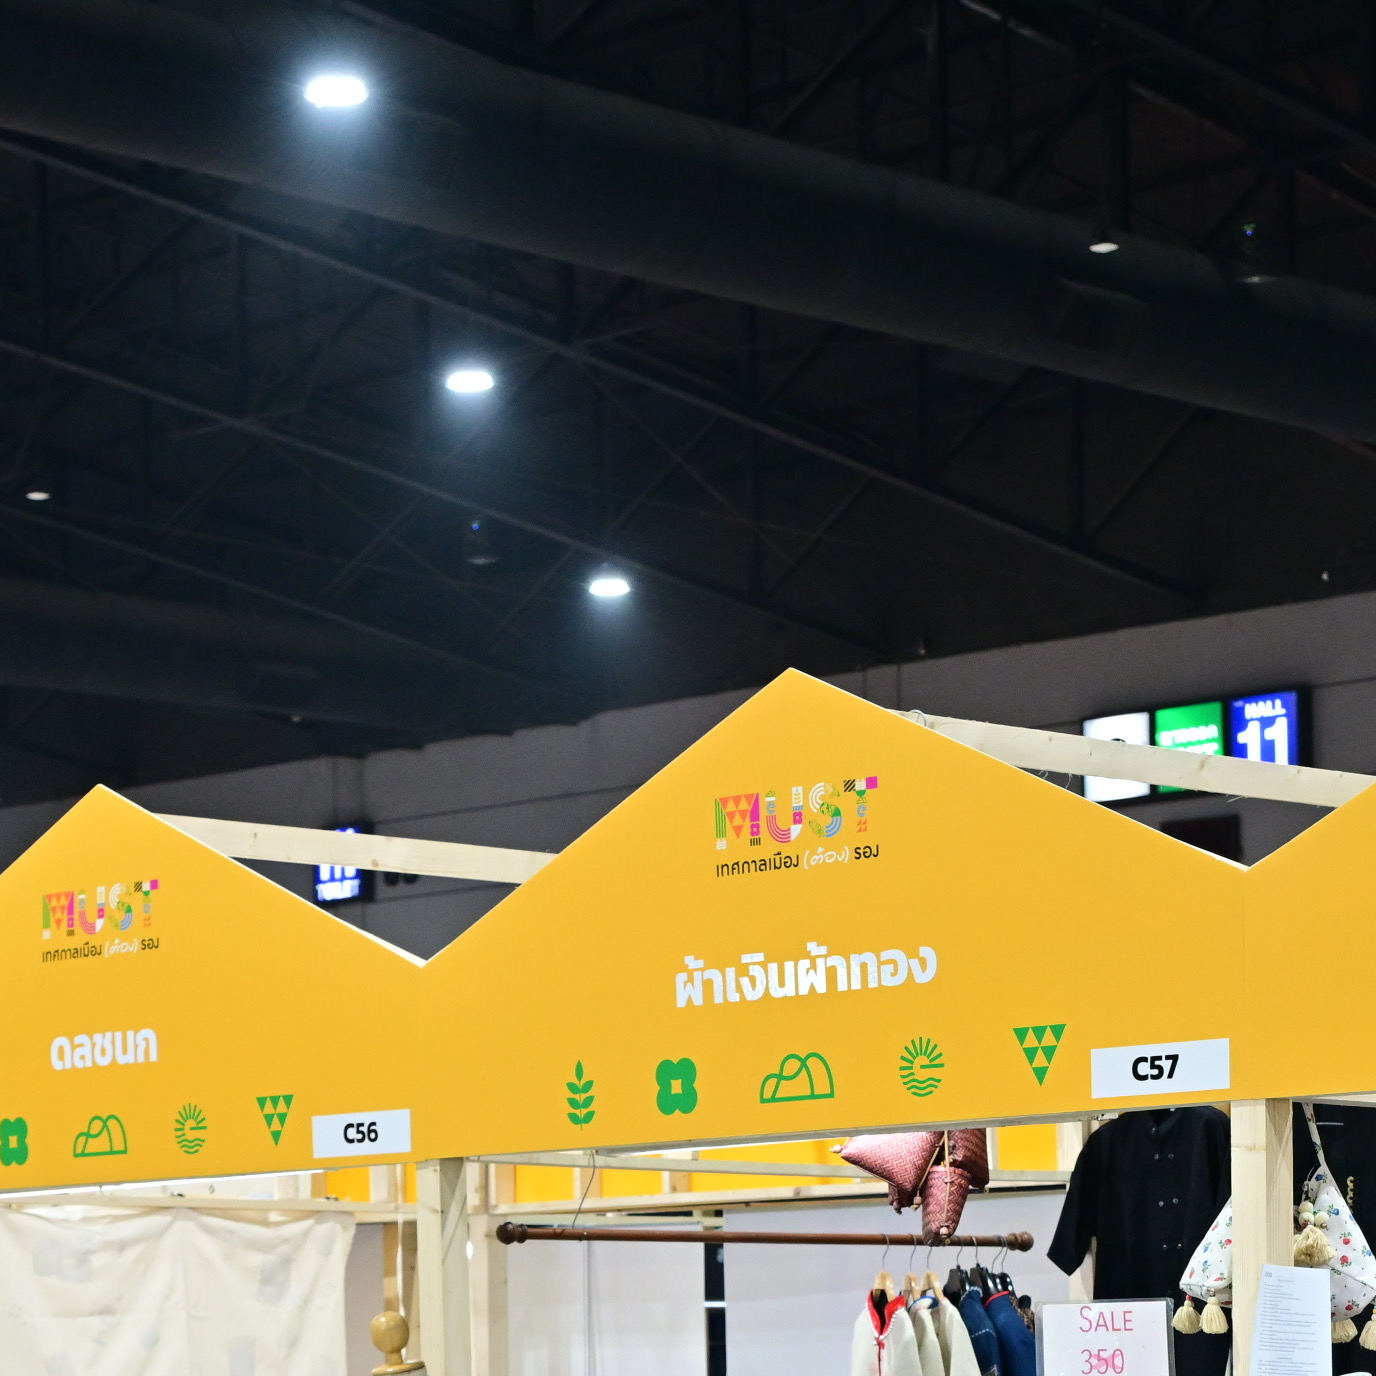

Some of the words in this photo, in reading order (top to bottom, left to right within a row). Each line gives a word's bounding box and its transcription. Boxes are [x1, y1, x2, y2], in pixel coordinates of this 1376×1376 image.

[1245, 699, 1286, 720] HALL
[1237, 716, 1288, 766] 11
[714, 775, 878, 850] MUST
[715, 850, 800, 878] เทศกาลเมือง
[854, 842, 880, 861] รอง
[42, 878, 159, 939] MUST
[42, 940, 102, 963] เทศกาลเมือง
[141, 935, 159, 952] รอง
[674, 940, 937, 1009] ผ้าเงินผ้าทอง
[50, 1027, 157, 1071] ดลชนก
[1131, 1054, 1179, 1082] C57
[342, 1121, 378, 1145] C56
[1079, 1305, 1134, 1333] SALE
[1081, 1348, 1125, 1375] 350
